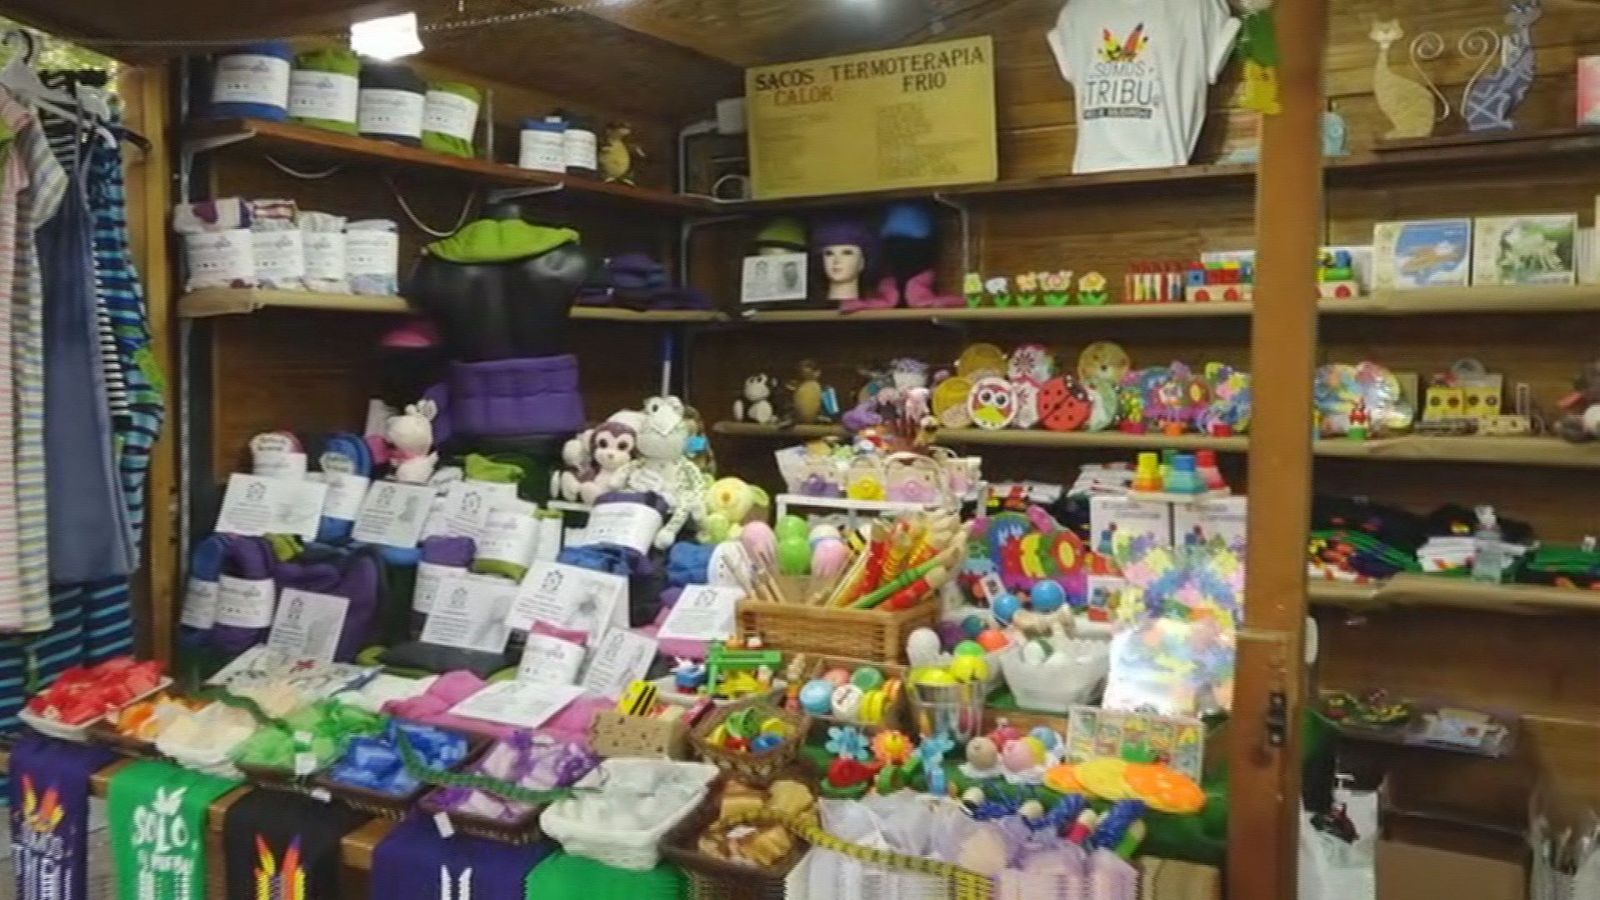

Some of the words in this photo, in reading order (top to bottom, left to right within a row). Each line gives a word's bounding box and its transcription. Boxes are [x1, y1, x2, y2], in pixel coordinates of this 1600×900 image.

[755, 68, 815, 91] SACOS
[829, 46, 985, 82] TERMOTERAPIA
[773, 86, 834, 107] CALOR
[903, 71, 946, 93] FRIO
[1086, 79, 1153, 106] TRIBU
[131, 806, 190, 854] SOLO
